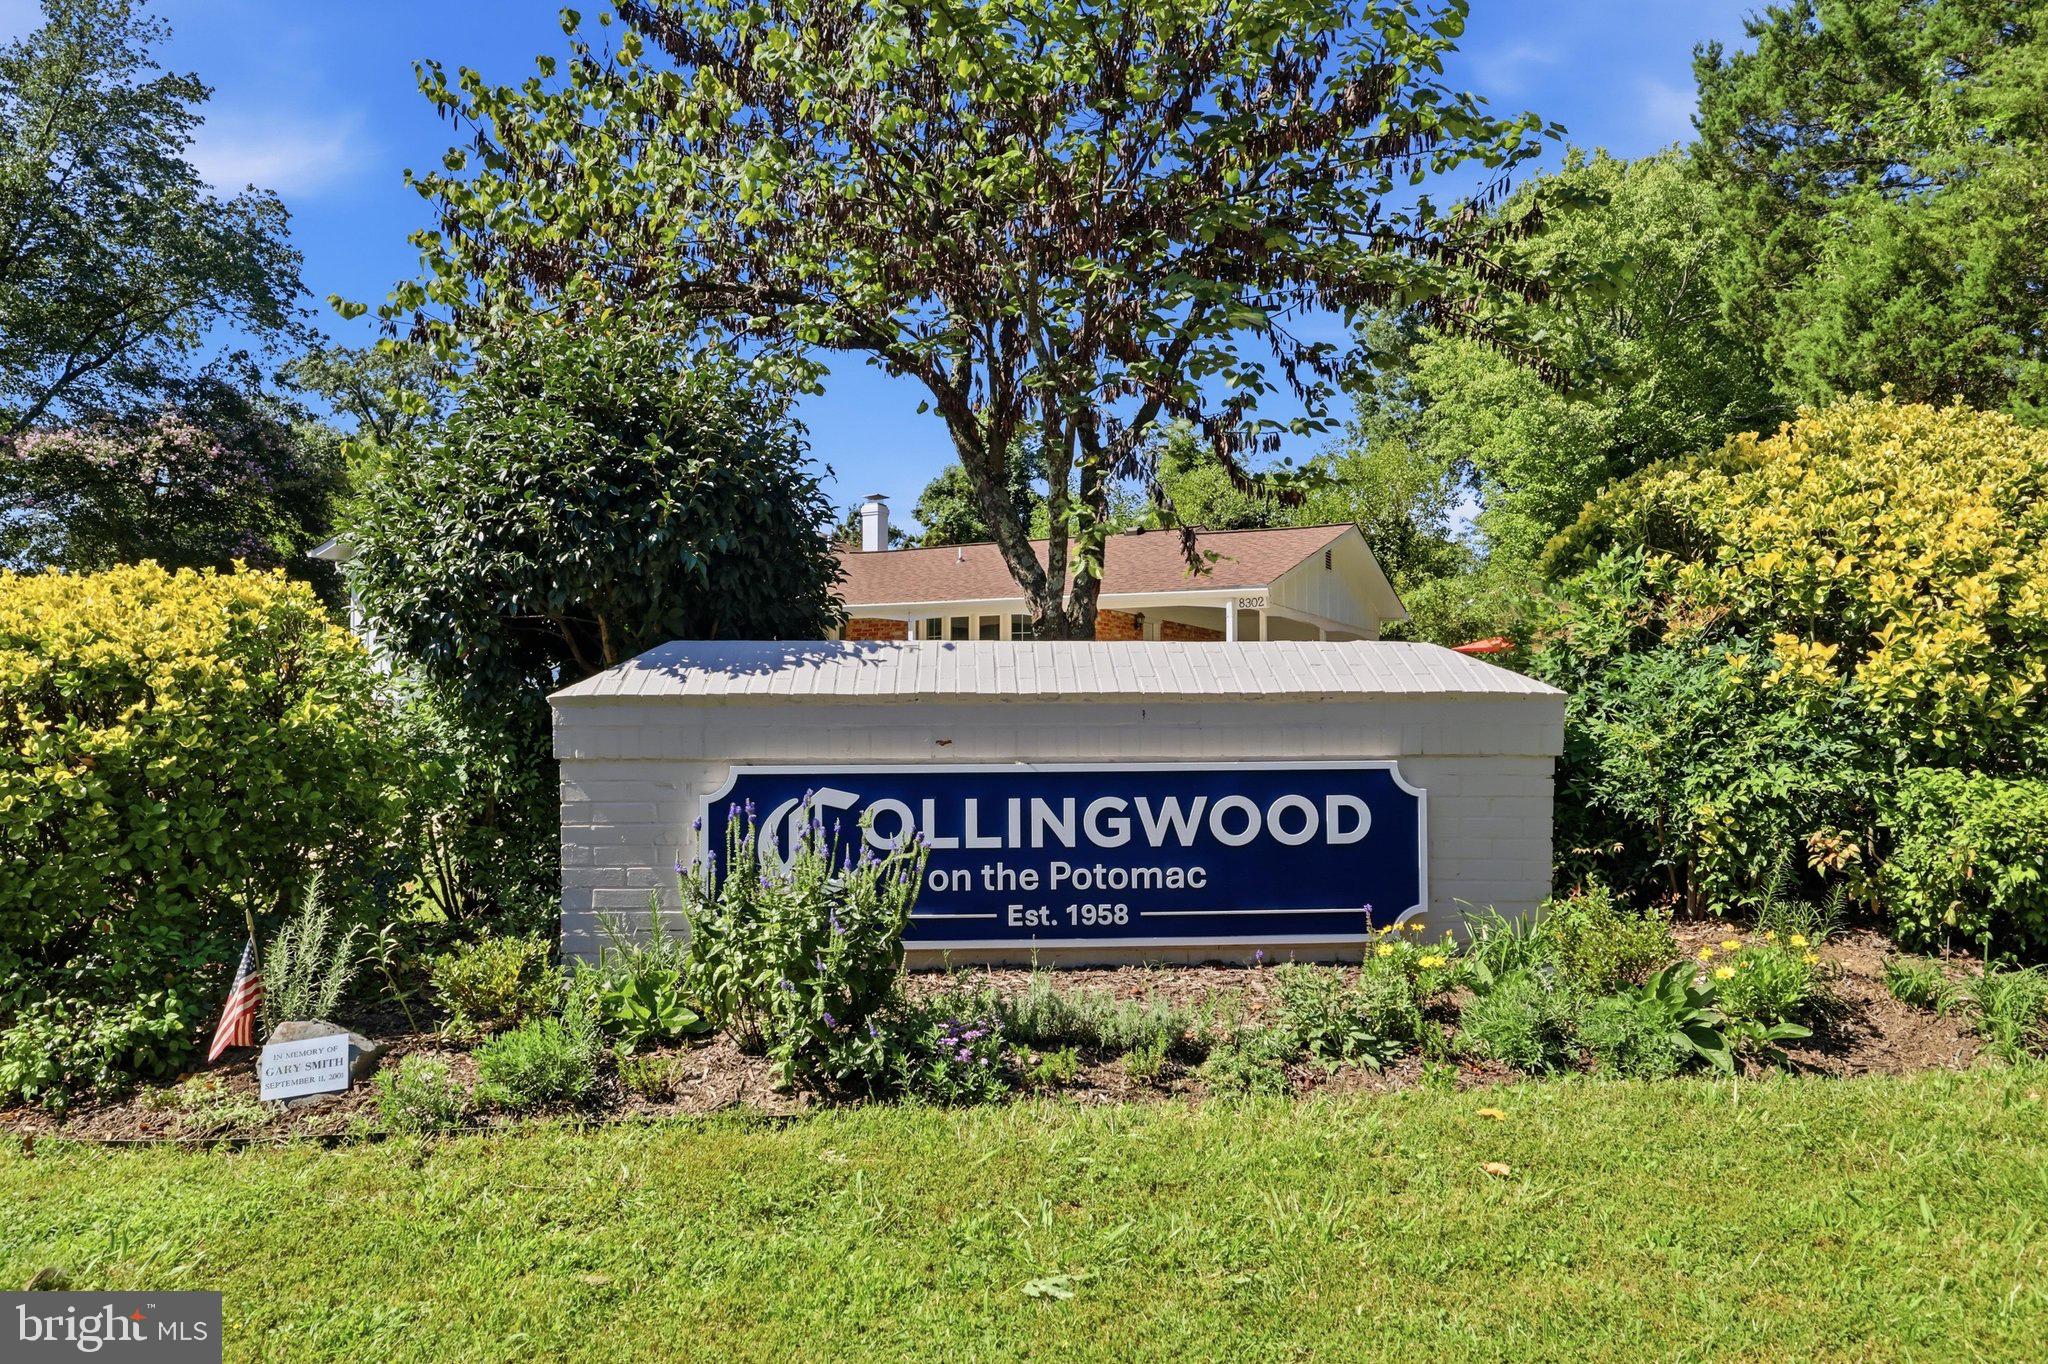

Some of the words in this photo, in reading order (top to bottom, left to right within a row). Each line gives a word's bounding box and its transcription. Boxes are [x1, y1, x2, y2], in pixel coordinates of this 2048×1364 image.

[1238, 596, 1265, 608] 8302
[928, 868, 971, 891] on
[981, 862, 1040, 891] the
[1050, 861, 1207, 890] Potomac
[1008, 904, 1058, 927] Est.
[1066, 903, 1129, 926] 1958
[273, 1052, 283, 1061] IN
[285, 1047, 324, 1060] MEMORY
[327, 1045, 339, 1053] OF
[265, 1062, 301, 1077] GARY
[305, 1057, 344, 1072] SMITH
[264, 1076, 316, 1090] SEPTEMBER
[328, 1072, 345, 1080] 2001
